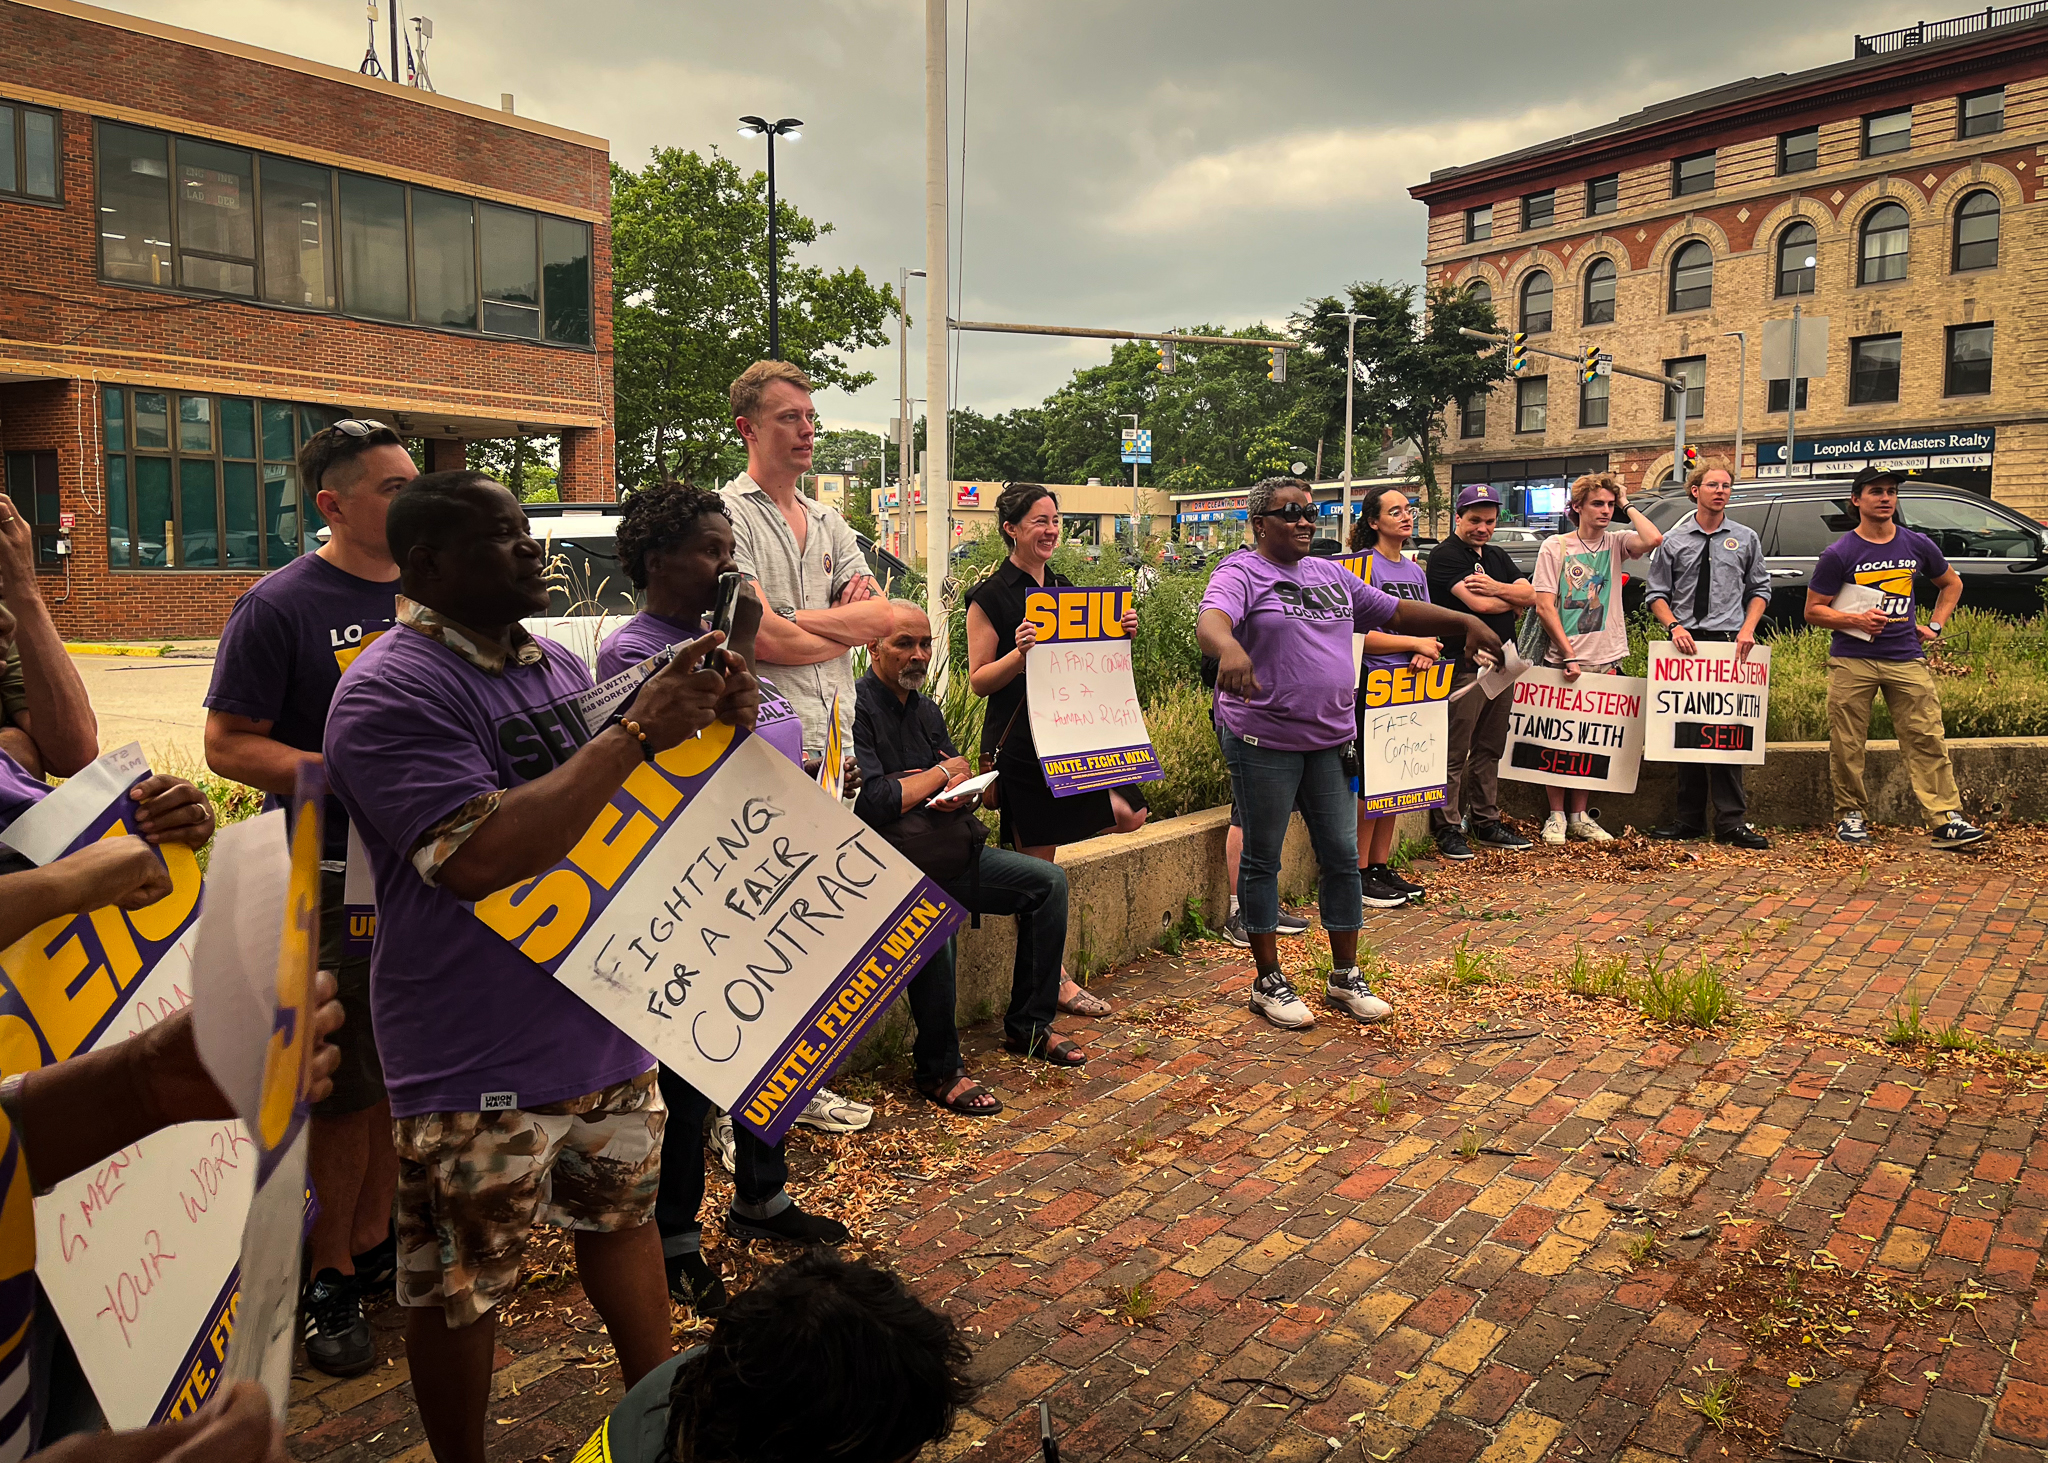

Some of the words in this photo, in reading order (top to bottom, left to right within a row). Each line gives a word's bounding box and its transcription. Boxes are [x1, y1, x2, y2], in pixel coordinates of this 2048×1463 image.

[1813, 442, 1861, 457] Leopold
[1865, 440, 1875, 452] &
[1878, 437, 1946, 452] McMasters
[1948, 433, 1991, 449] Realty
[1825, 463, 1854, 471] SALES
[1873, 458, 1925, 469] 617-208-8020
[1939, 455, 1984, 465] RENTALS
[1855, 559, 1895, 572] LOCAL
[1897, 559, 1917, 569] 509
[1273, 581, 1349, 610] SEIU
[1026, 591, 1132, 642] SEIU
[1281, 604, 1333, 621] LOCAL
[1050, 650, 1062, 674] A
[1064, 650, 1098, 674] FAIR
[1655, 657, 1768, 686] NORTHEASTERN
[580, 687, 604, 704] STAND
[605, 672, 631, 691] WITH
[597, 680, 641, 707] WORKERS
[1051, 686, 1070, 702] IS
[1080, 683, 1094, 698] A
[1365, 663, 1455, 707] SEIU
[1098, 698, 1138, 727] RIGHT
[1513, 681, 1641, 718] ORTHEASTERN
[1656, 690, 1734, 716] STANDS
[1736, 693, 1761, 718] WITH
[1372, 711, 1423, 739] FAIR
[1578, 720, 1625, 748] WITH
[1700, 725, 1744, 749] SEIU
[498, 699, 592, 781] SEI
[1384, 733, 1436, 764] Contract
[1044, 758, 1087, 776] UNITE.
[1086, 753, 1125, 770] FIGHT.
[1123, 749, 1155, 765] WIN.
[1538, 749, 1593, 775] SEIU
[1367, 797, 1397, 811] UNITE.
[1397, 792, 1424, 806] FIGHT.
[1424, 789, 1446, 802] WIN.
[474, 720, 736, 963] SEIU
[594, 796, 783, 992] FIGHTING
[647, 963, 700, 1020] FOR
[701, 927, 730, 956] A
[725, 837, 810, 921] FAIR
[692, 828, 887, 1062] CONTRACT
[743, 1039, 827, 1126] UNITE.
[815, 956, 893, 1039] FIGHT.
[880, 897, 947, 961] WIN.
[485, 1094, 512, 1102] UNION
[179, 1124, 255, 1224] WORK
